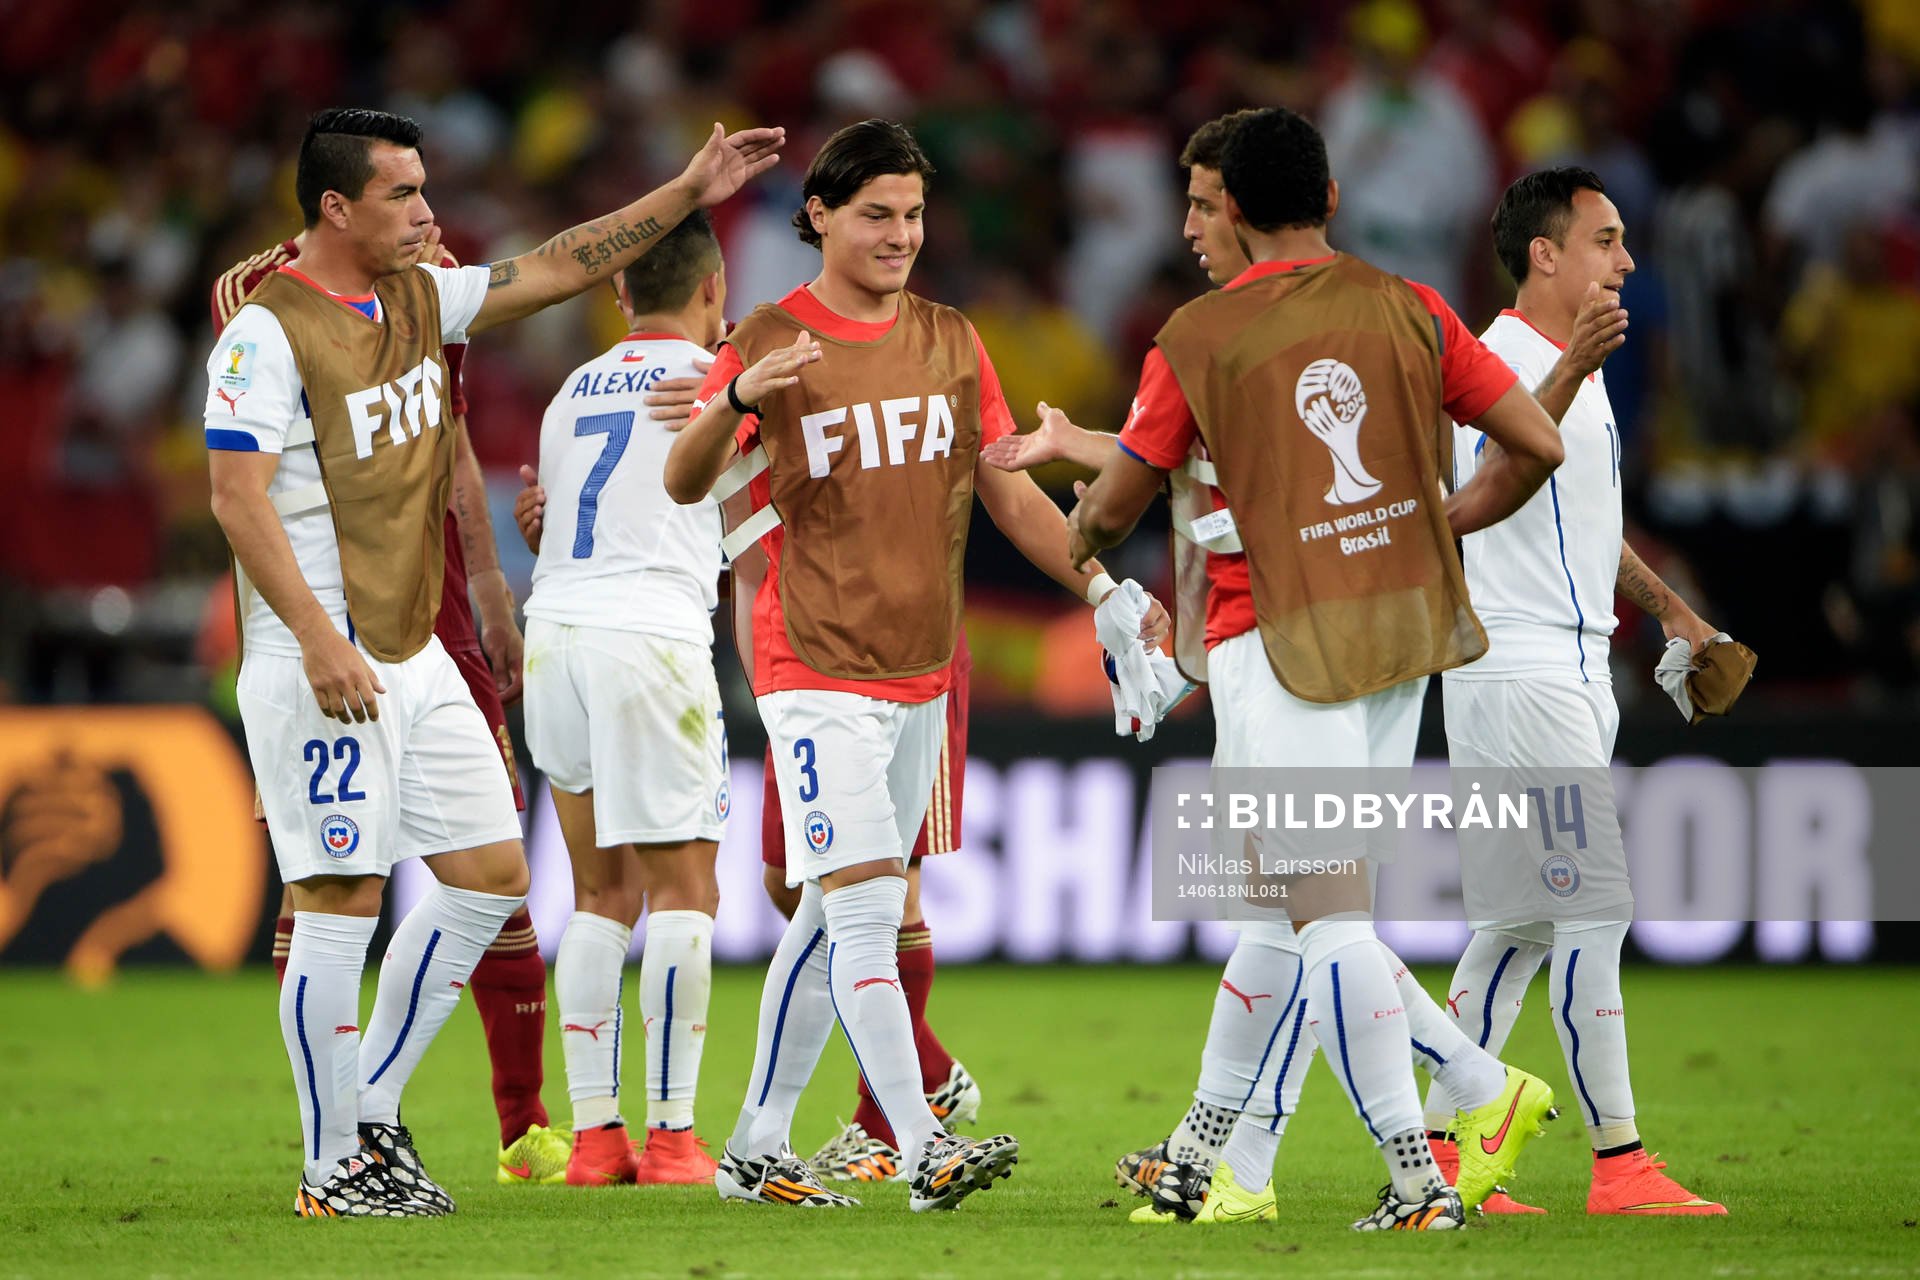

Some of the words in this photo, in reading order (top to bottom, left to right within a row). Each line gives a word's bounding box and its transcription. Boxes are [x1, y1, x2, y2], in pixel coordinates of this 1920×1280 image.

[571, 216, 664, 276] Esteban
[571, 367, 666, 399] ALEXIS
[800, 394, 955, 480] FIFA
[572, 410, 636, 560] 7
[1299, 521, 1335, 543] FIFA
[1334, 507, 1388, 533] WORLD
[1388, 498, 1417, 518] CUP
[303, 736, 366, 805] 22
[793, 738, 819, 803] 3
[1526, 783, 1588, 851] 14
